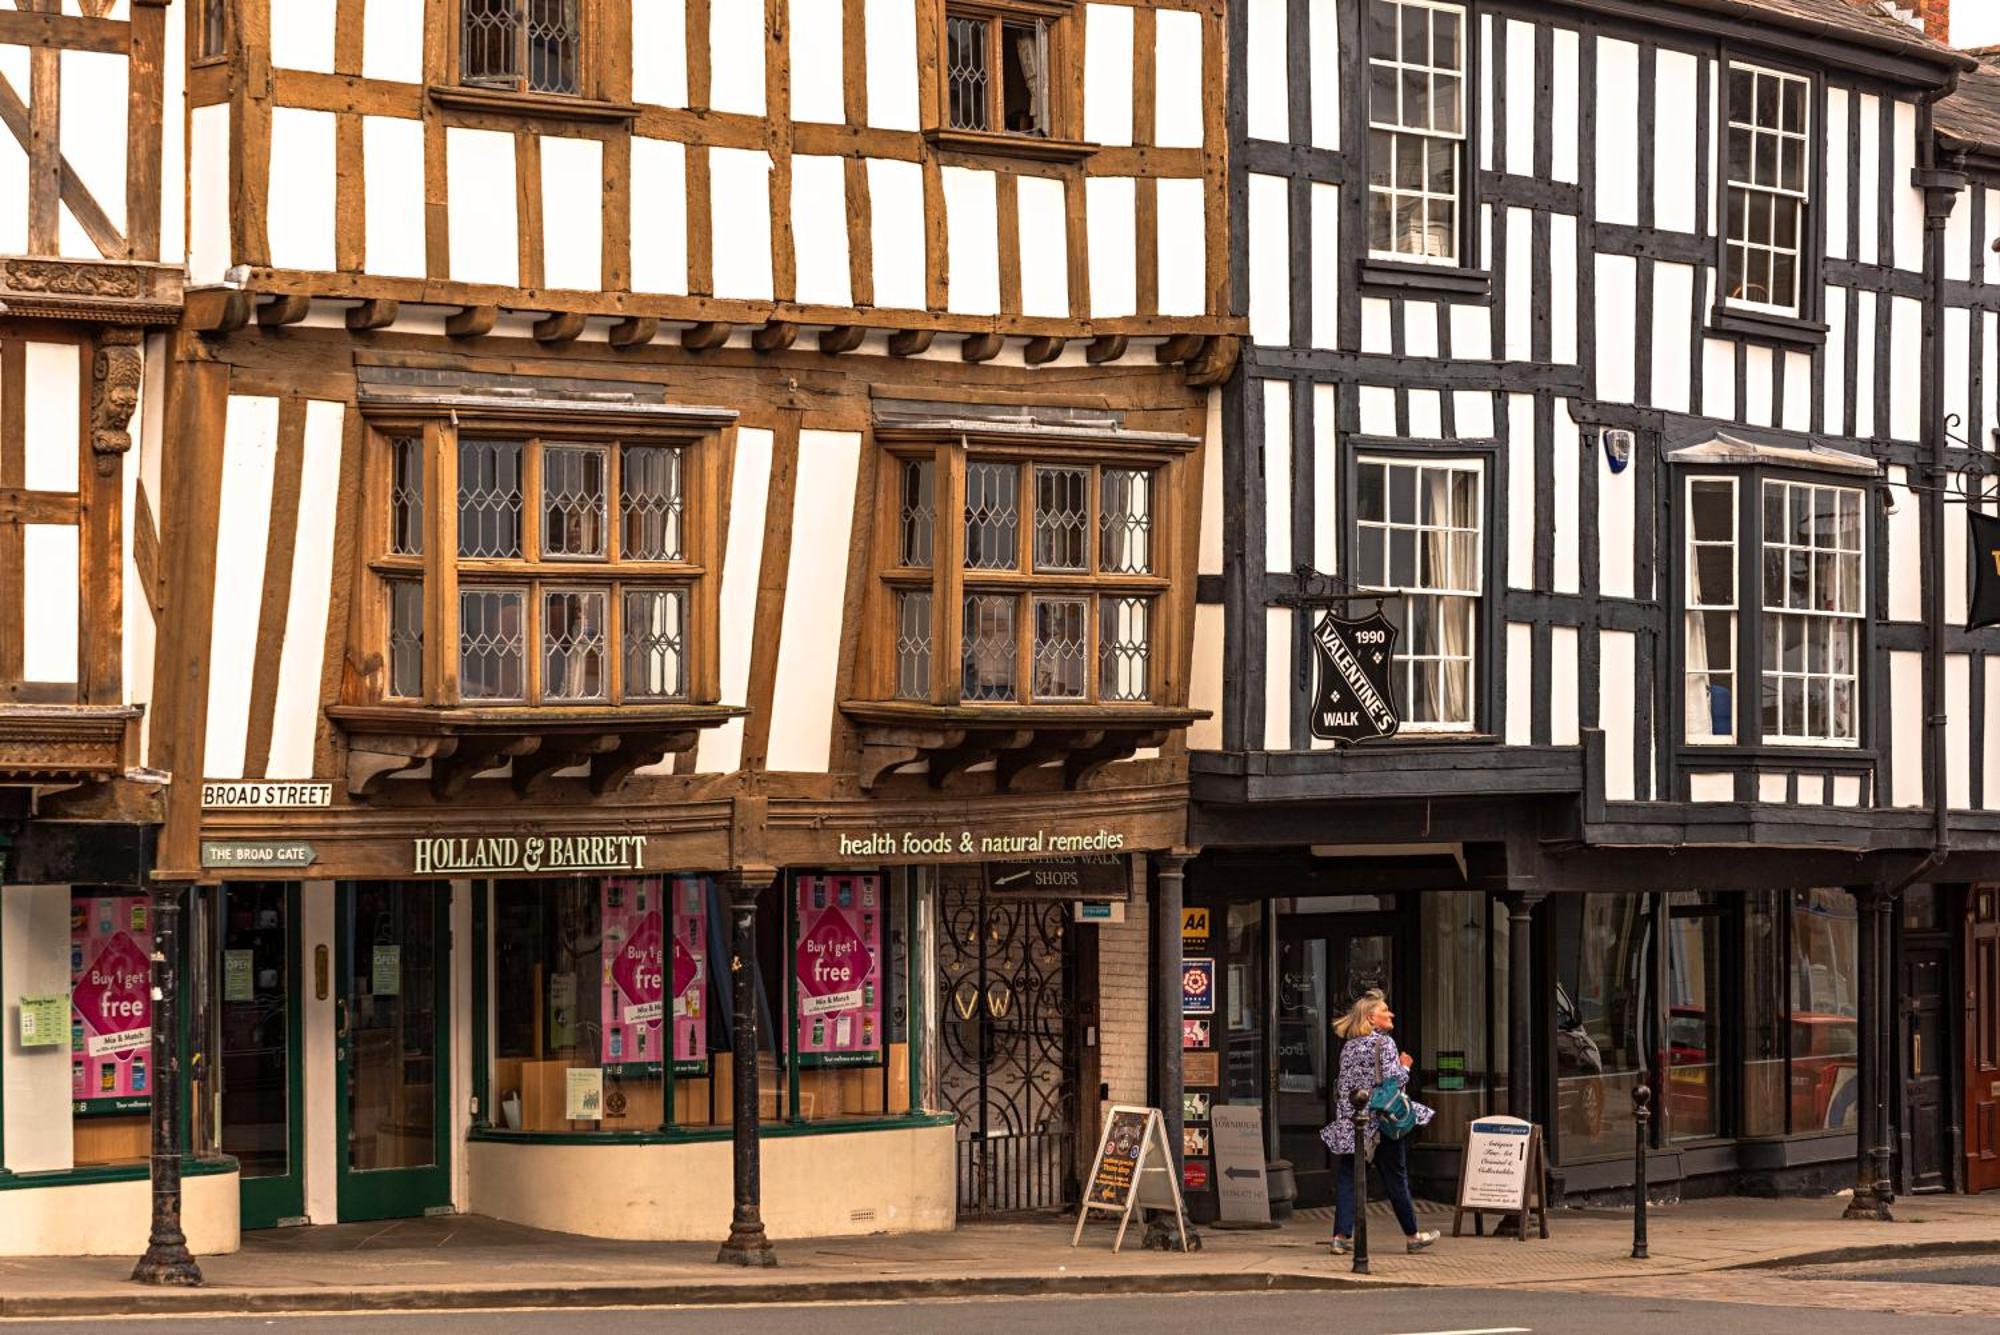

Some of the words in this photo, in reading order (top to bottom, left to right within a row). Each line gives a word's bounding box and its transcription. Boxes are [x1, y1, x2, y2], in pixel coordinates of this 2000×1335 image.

[1355, 630, 1385, 644] 1990
[1321, 626, 1392, 731] VALENTINE'S
[1323, 711, 1359, 727] WALK
[204, 786, 260, 804] BROAD
[265, 786, 328, 804] STREET
[840, 833, 895, 855] health
[902, 831, 951, 854] foods
[960, 831, 973, 852] &
[982, 830, 1043, 852] natural
[1049, 829, 1124, 850] remedies
[210, 848, 232, 860] THE
[237, 848, 273, 860] BROAD
[277, 848, 306, 860] GATE
[414, 838, 519, 873] HOLLAND
[523, 837, 545, 872] &
[549, 836, 647, 869] BARRETT
[1035, 871, 1078, 885] SHOPS
[1183, 914, 1206, 930] AA
[628, 946, 647, 964] Buy
[807, 940, 825, 957] Buy
[829, 941, 833, 952] 1
[835, 941, 851, 957] get
[853, 940, 857, 952] 1
[635, 966, 662, 989] fre
[814, 959, 850, 981] free
[92, 970, 114, 990] Buy
[116, 970, 122, 983] 1
[125, 972, 144, 989] get
[101, 991, 143, 1017] free
[955, 990, 978, 1020] V
[987, 988, 1010, 1017] W
